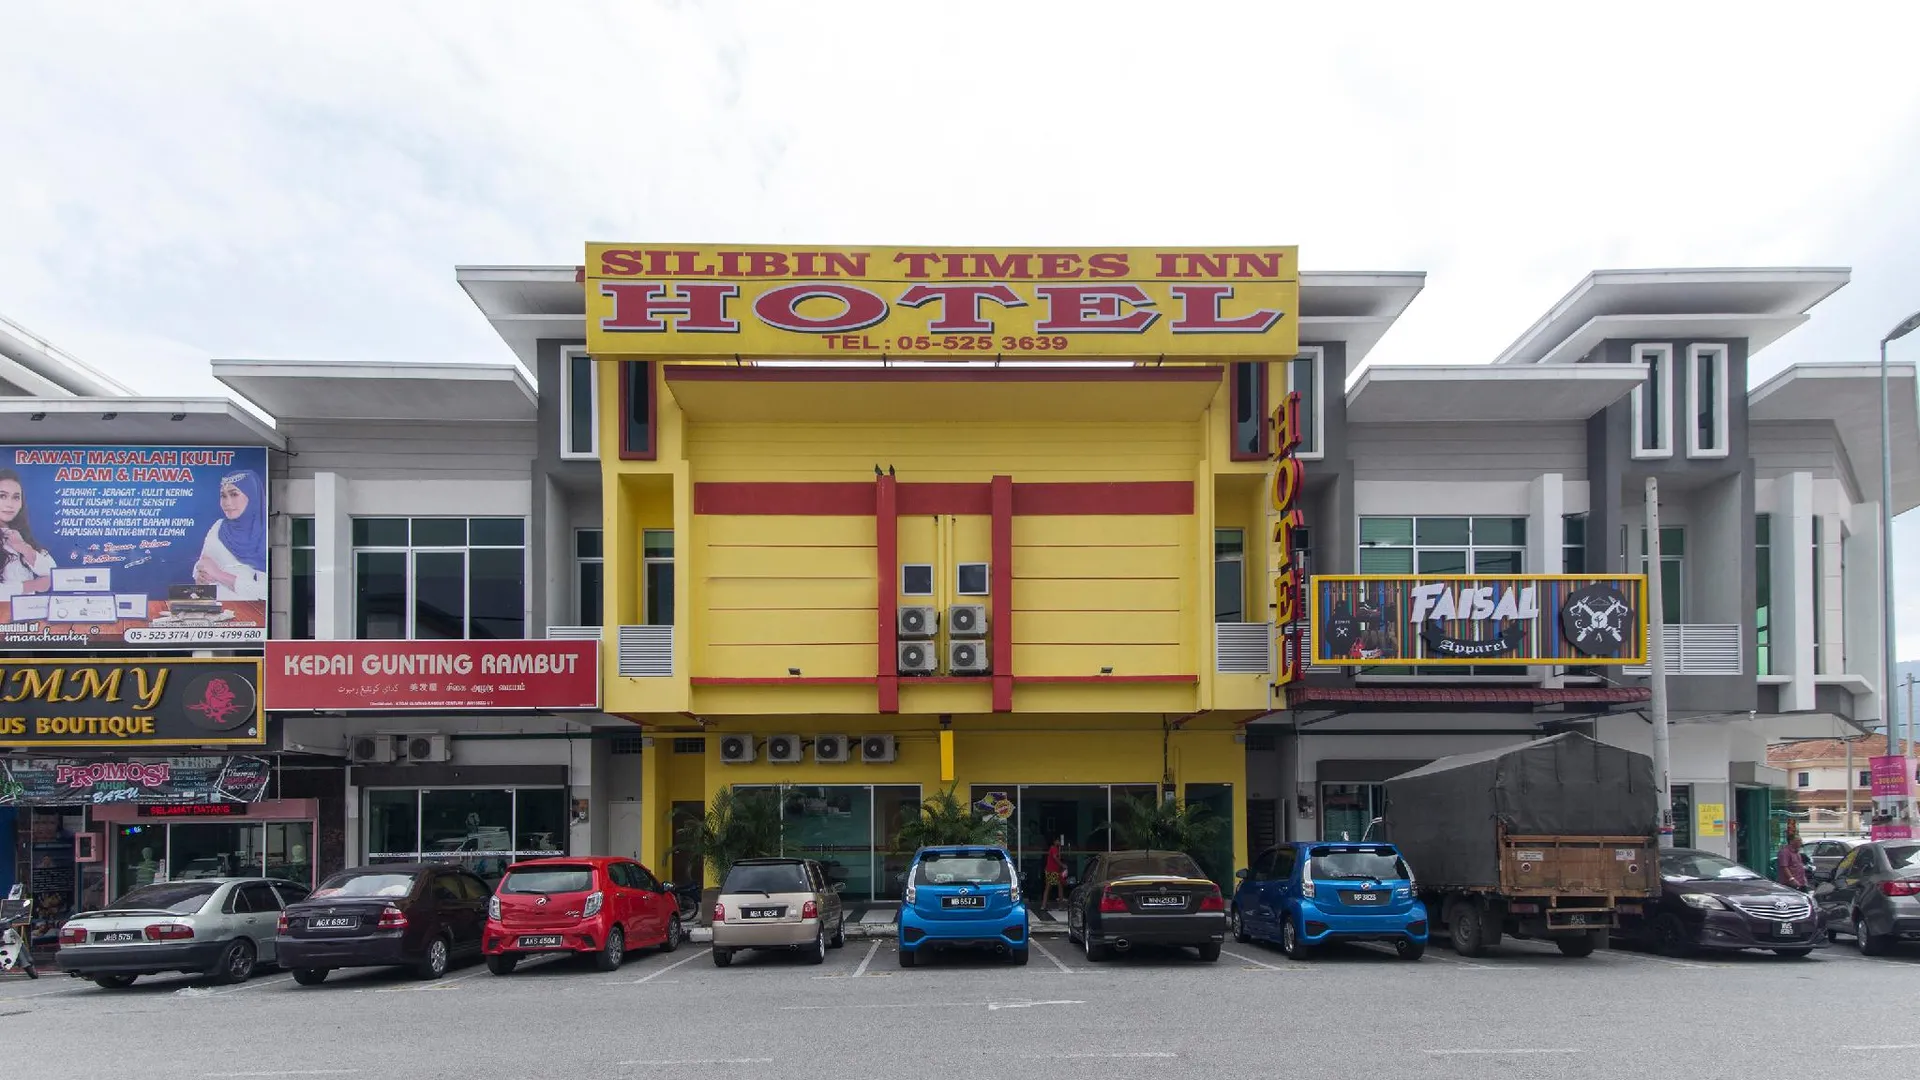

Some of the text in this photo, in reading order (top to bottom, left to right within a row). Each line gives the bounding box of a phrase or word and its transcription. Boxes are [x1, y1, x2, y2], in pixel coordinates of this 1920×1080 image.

[600, 249, 1284, 278] SILIBIN TIMES INN
[600, 281, 1286, 335] HOTEL
[898, 336, 993, 350] 05-525
[1001, 336, 1068, 350] 3639
[15, 450, 235, 466] RAWAT MASALAH KULIT
[55, 467, 194, 482] ADAM & HAWA
[61, 488, 97, 497] JERAWAT
[102, 488, 136, 496] JERAGAT
[142, 488, 164, 496] KULIT
[165, 488, 193, 497] KERING
[61, 498, 84, 506] KULIT
[85, 498, 113, 506] KUSAM
[119, 498, 141, 506] KULIT
[142, 498, 177, 506] SENSITIF
[61, 508, 99, 516] MASALAH
[139, 508, 161, 516] KULIT
[61, 518, 194, 526] KULIT ROSAK AKIBAT BAHAN KIMIA
[61, 528, 102, 536] HAPUSKAN
[158, 528, 186, 536] LEMAK
[1271, 391, 1305, 687] HOTEL
[1410, 583, 1539, 623] FAISAL
[29, 622, 39, 632] of
[130, 631, 141, 640] 05
[149, 631, 166, 640] 525
[167, 631, 189, 640] 3774
[197, 631, 214, 639] 019
[220, 630, 242, 639] 4799
[243, 630, 261, 639] 680
[1437, 639, 1508, 655] Apparel
[284, 653, 579, 676] KEDAI GUNTING RAMBUT
[0, 667, 170, 711] MMY
[36, 716, 156, 738] BOUTIQUE
[56, 762, 171, 788] PROMOSI
[92, 787, 140, 803] BARU
[149, 805, 231, 815] SELAMAT DATANG
